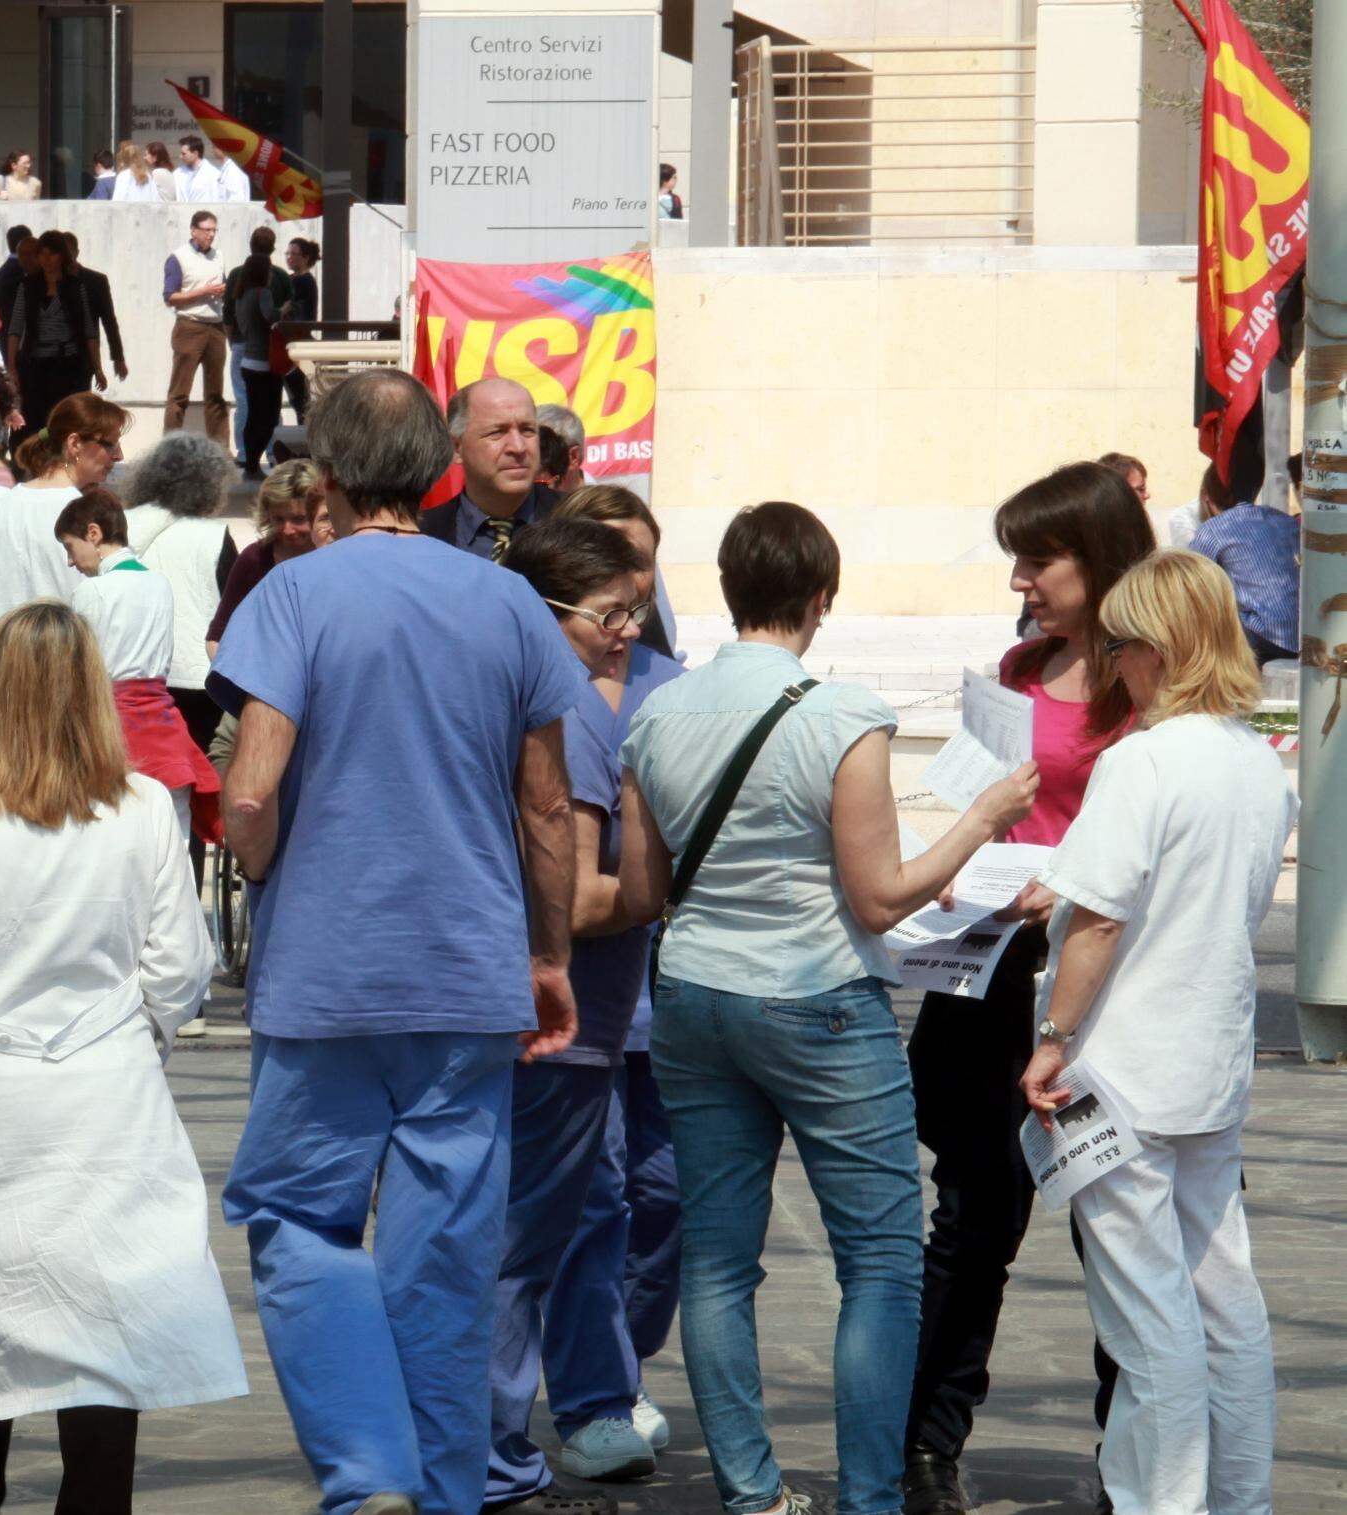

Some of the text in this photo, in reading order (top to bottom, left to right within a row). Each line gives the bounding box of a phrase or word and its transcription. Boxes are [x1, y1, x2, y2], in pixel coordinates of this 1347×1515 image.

[470, 35, 602, 54] Centro Servizi
[479, 64, 593, 82] Ristorazione
[132, 104, 175, 117] Basilica
[132, 118, 152, 131] San
[430, 132, 556, 153] FAST FOOD
[430, 165, 531, 186] PIZZERIA
[572, 197, 647, 211] Piano Terra
[586, 440, 653, 463] DI BAS
[902, 957, 984, 975] Non uno di meno
[1039, 1126, 1118, 1184] Non uno di meno
[1092, 1144, 1122, 1167] R.S.U.
